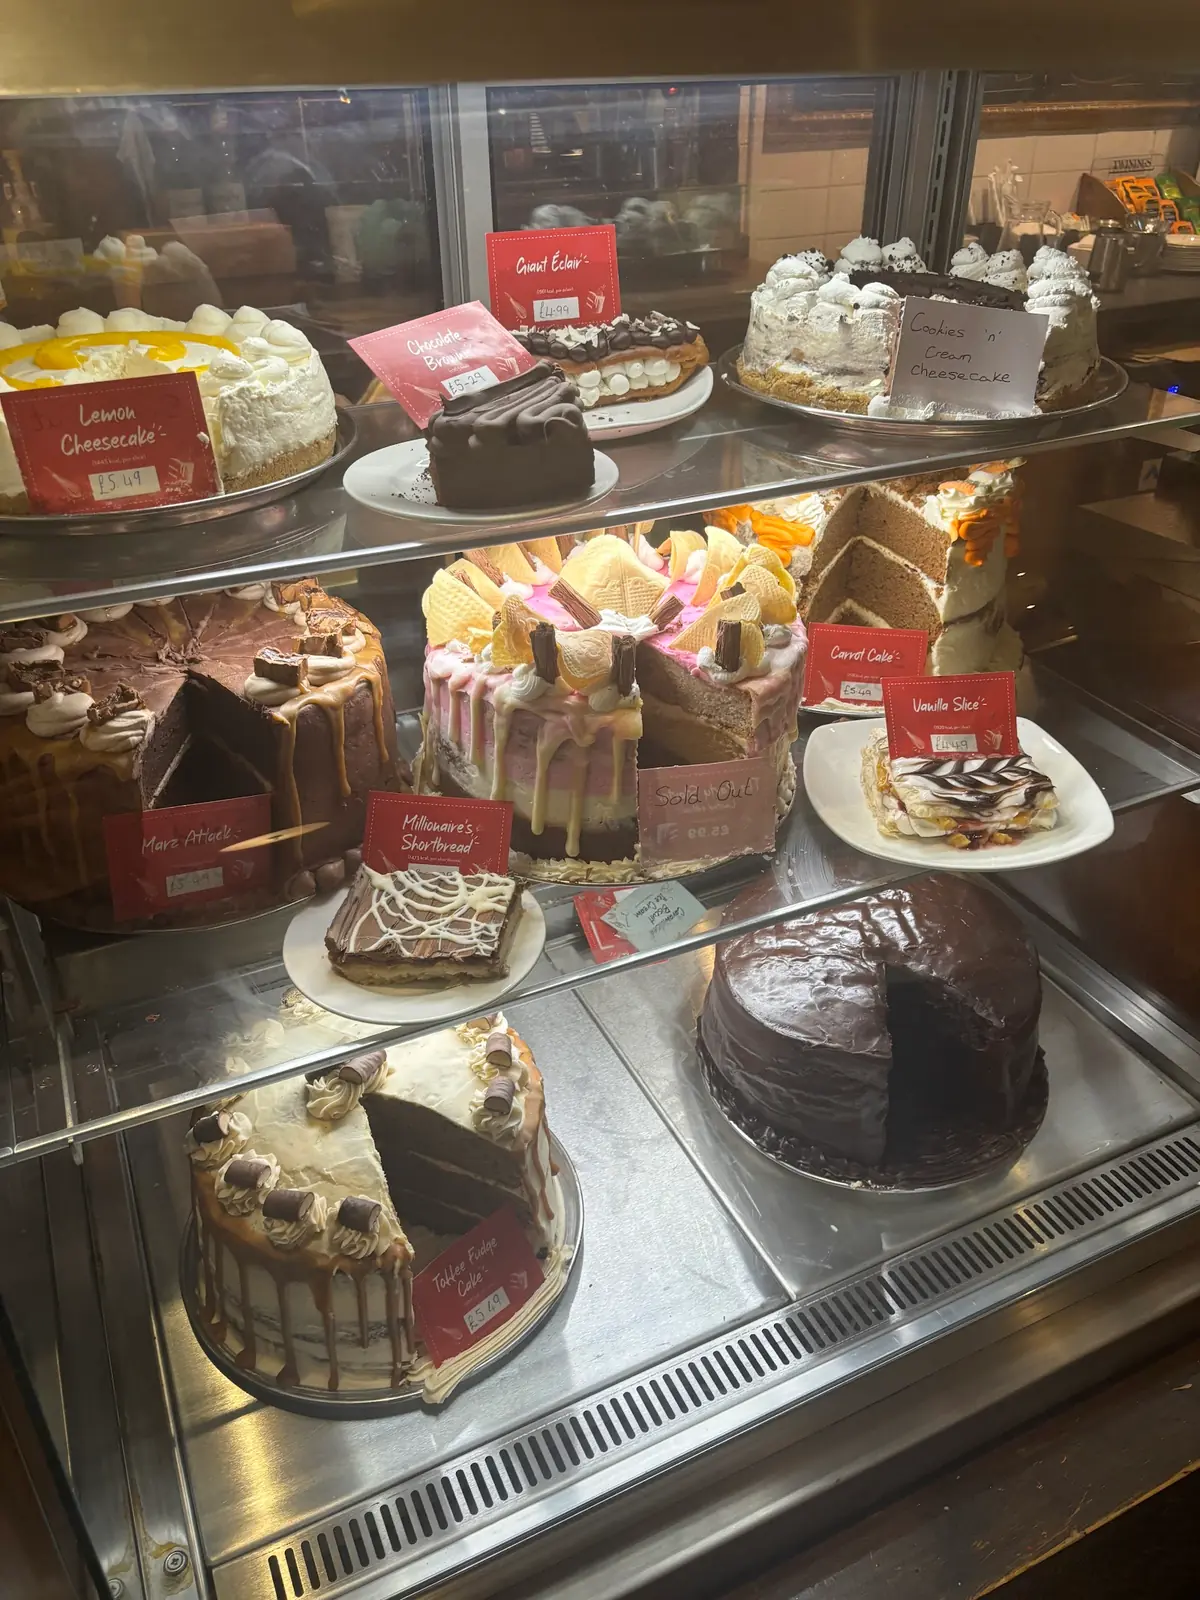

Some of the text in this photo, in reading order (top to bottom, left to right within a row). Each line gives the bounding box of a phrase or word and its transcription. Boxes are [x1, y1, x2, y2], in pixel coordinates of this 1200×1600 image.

[516, 250, 583, 275] Giant Éclair
[540, 301, 569, 319] £4.99
[910, 312, 1002, 342] Cookies 'n'
[407, 328, 462, 355] Chocolate
[924, 346, 972, 363] Cream
[79, 404, 136, 427] Lemon
[61, 426, 156, 456] Cheesecake
[98, 470, 142, 495] £5.49
[830, 645, 893, 663] Carrot Cake
[912, 696, 980, 713] Vanilla Slice
[654, 784, 702, 807] Sold
[717, 777, 753, 801] Out
[402, 814, 473, 834] Millionaire's
[184, 824, 232, 848] Attack
[401, 833, 474, 854] Shortbread
[634, 901, 657, 918] Cream
[648, 904, 671, 925] Biscuit
[432, 1237, 498, 1292] Toffee Fudge
[457, 1271, 484, 1297] Cake
